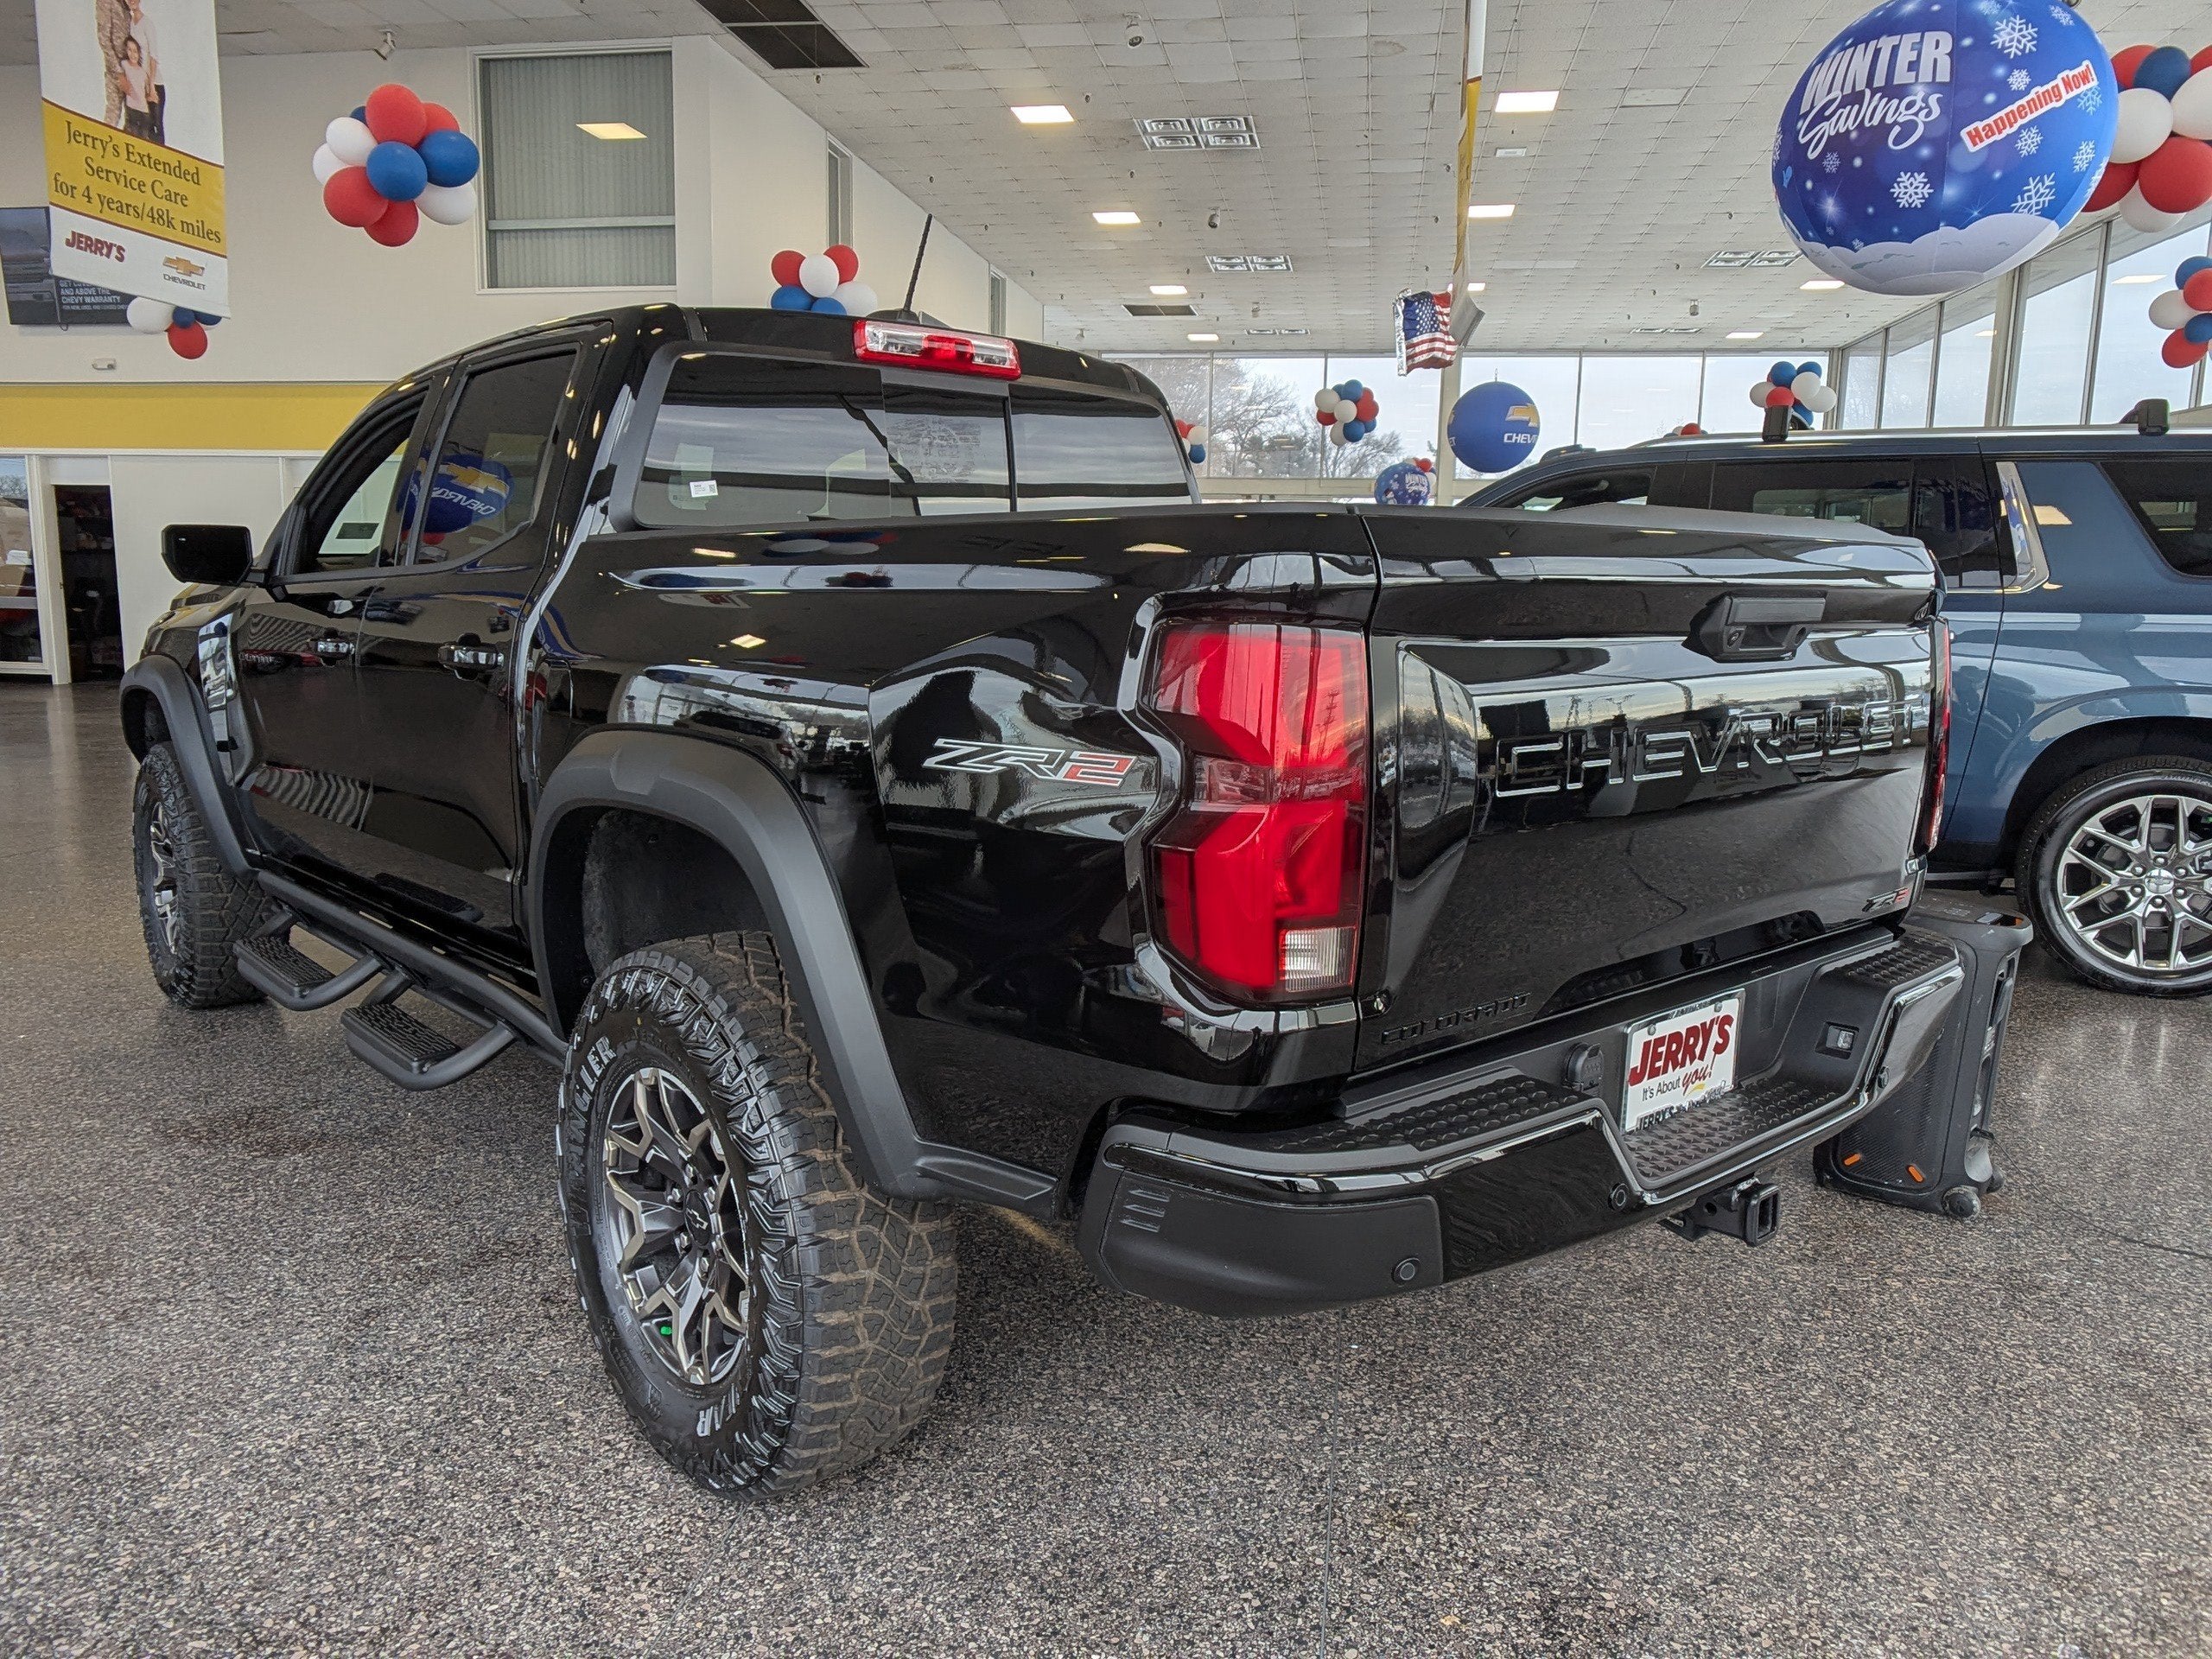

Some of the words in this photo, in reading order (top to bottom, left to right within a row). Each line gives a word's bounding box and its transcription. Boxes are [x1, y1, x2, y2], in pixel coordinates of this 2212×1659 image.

[1800, 31, 1953, 115] WINTER
[1799, 86, 1943, 160] Savings
[1966, 83, 2062, 149] Happening
[2060, 64, 2095, 99] Now!
[66, 120, 120, 158] Jerry's
[124, 142, 201, 186] Extended
[85, 156, 146, 194] Service
[151, 179, 188, 207] Care
[54, 173, 77, 199] for
[81, 186, 92, 204] 4
[97, 192, 177, 231] years/48k
[181, 219, 221, 244] miles
[65, 230, 126, 263] JERRY'S
[163, 273, 207, 291] CHEVROLET
[921, 737, 1140, 788] ZR2
[1496, 696, 1925, 798] CHEVROLET
[1382, 991, 1532, 1045] COLORADO
[1628, 1014, 1735, 1087] JERRY'S
[1643, 1086, 1655, 1102] It's
[1656, 1076, 1681, 1096] About
